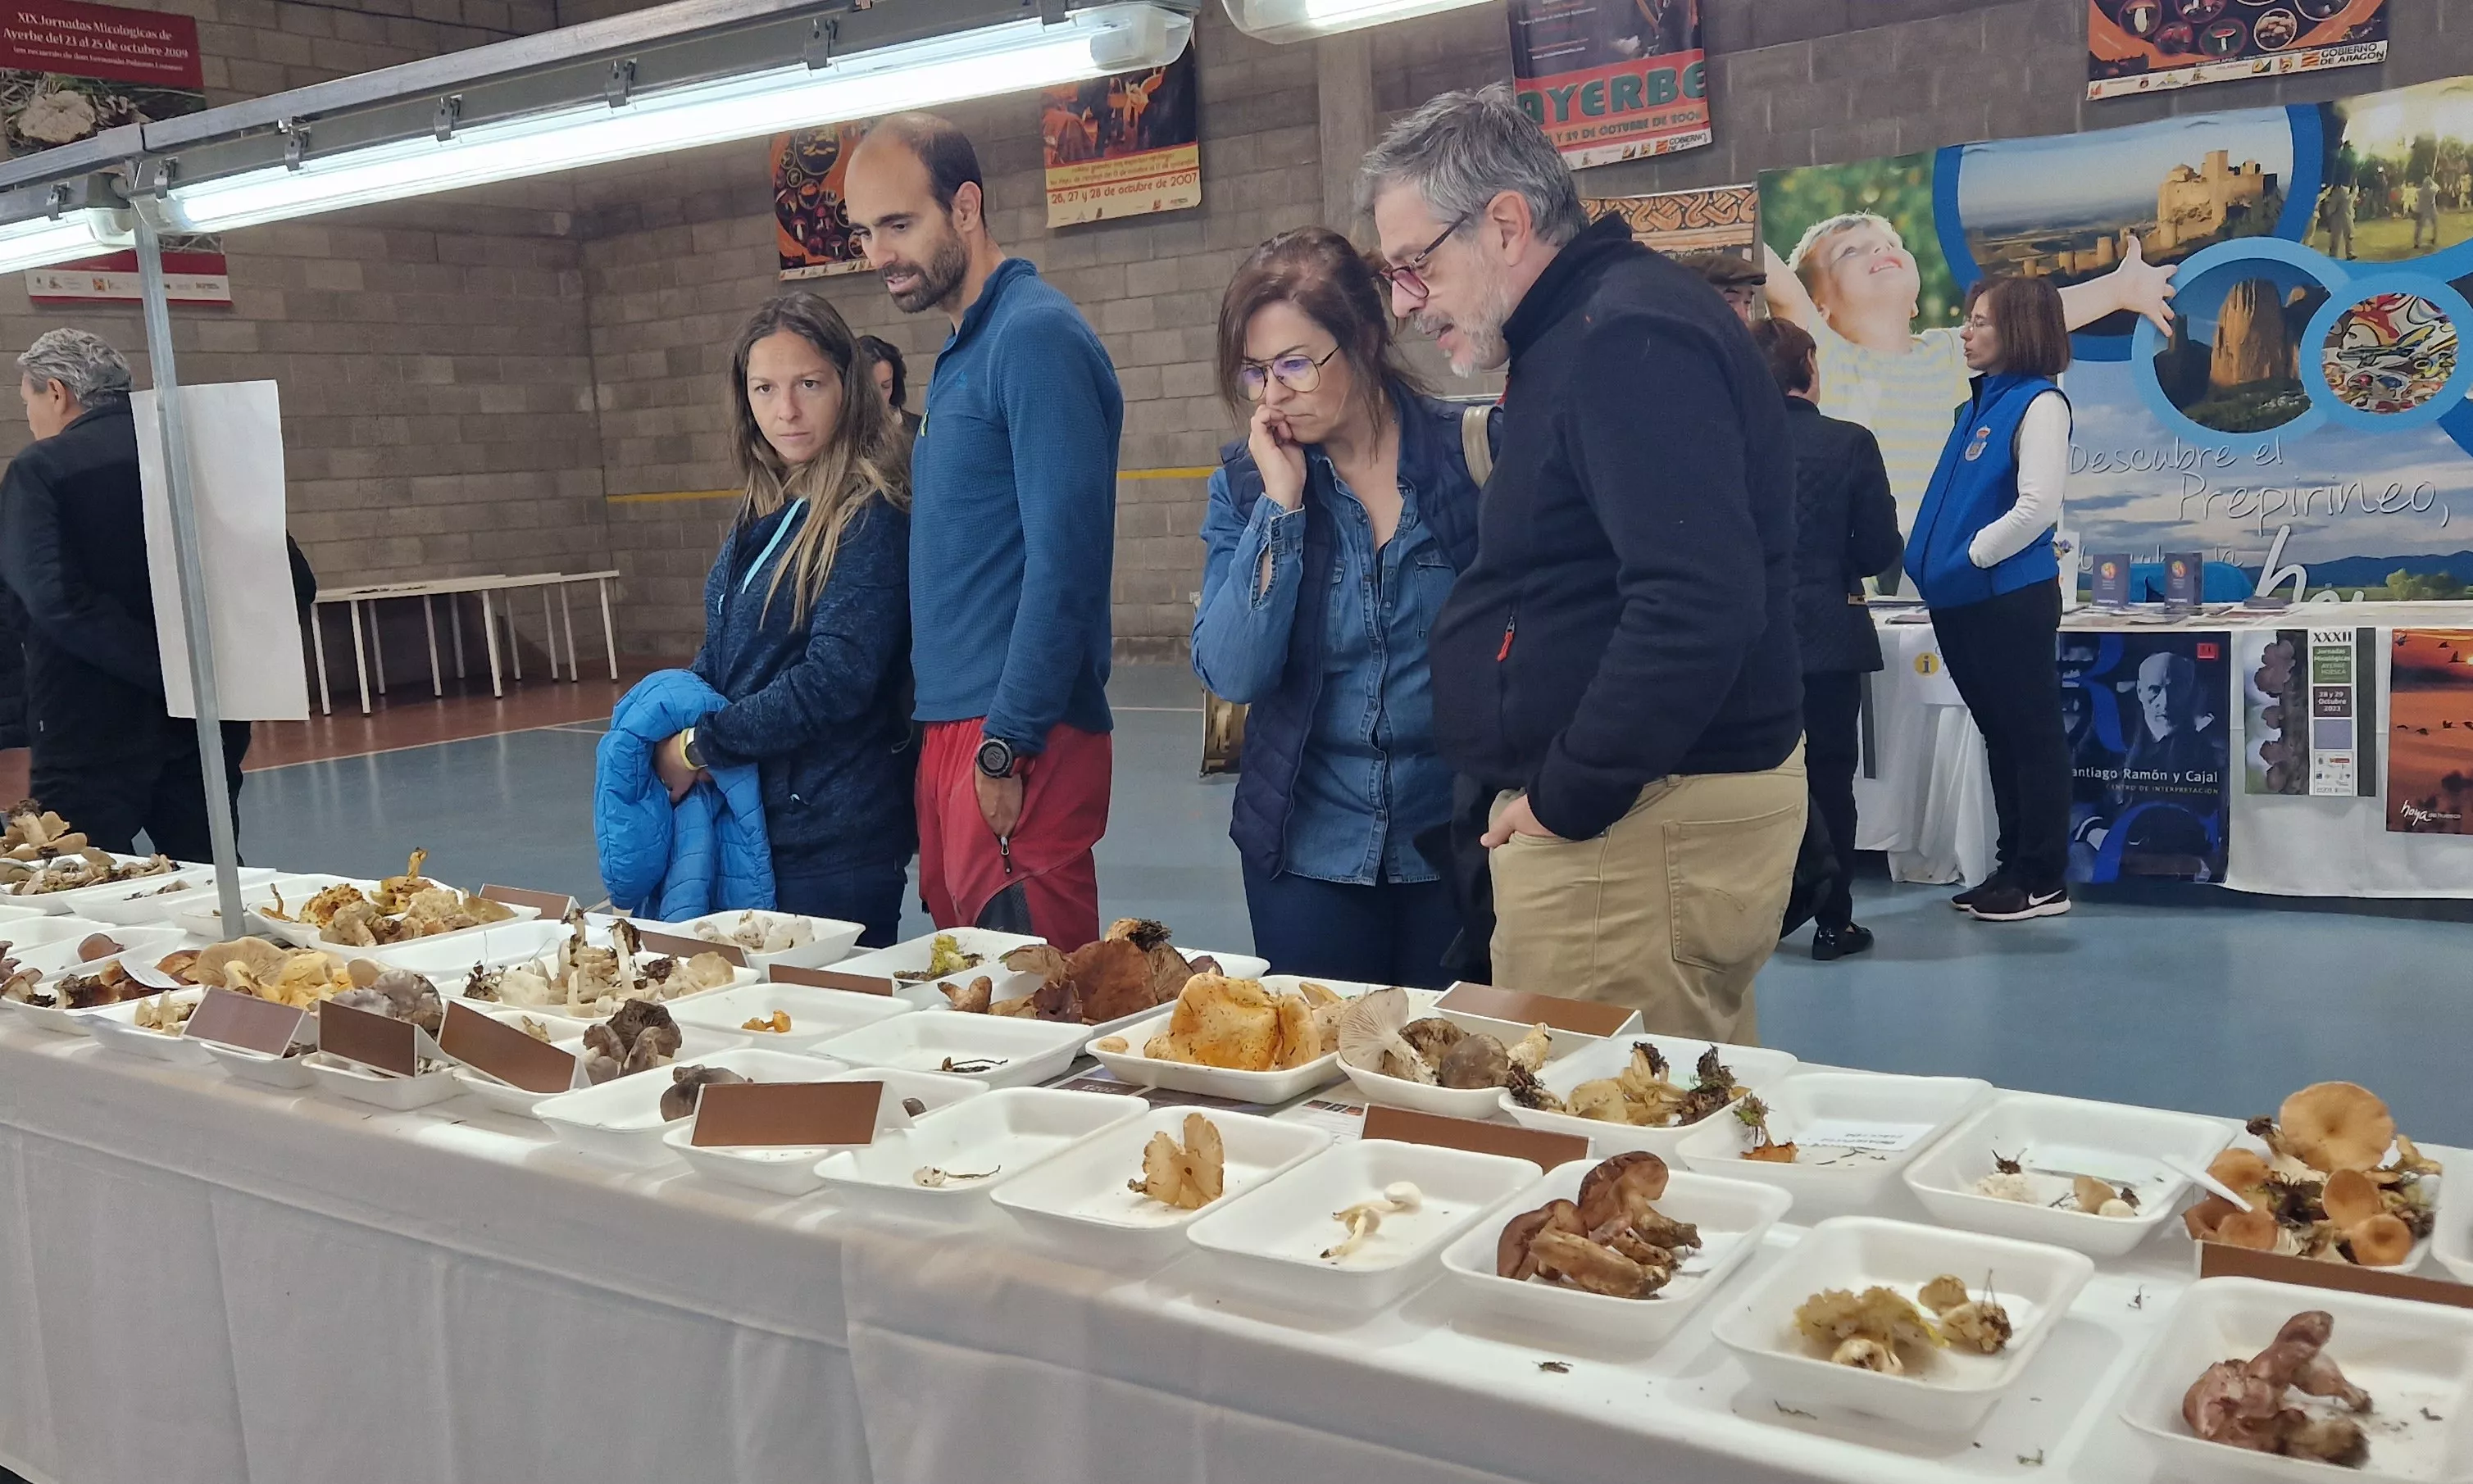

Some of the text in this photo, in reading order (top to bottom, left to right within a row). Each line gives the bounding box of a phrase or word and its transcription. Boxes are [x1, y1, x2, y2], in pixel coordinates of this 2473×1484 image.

[17, 11, 39, 24] XIX
[39, 15, 93, 31] Jornadas
[159, 29, 173, 41] de
[3, 27, 189, 59] Ayerbe del 23 al 25 de octubre 2009
[2321, 43, 2378, 58] GOBIERNO
[1517, 61, 1707, 125] AYERBE
[1068, 191, 1079, 202] 27
[1082, 192, 1088, 203] y
[1089, 188, 1102, 198] 28
[1104, 186, 1116, 197] de
[1118, 181, 1152, 194] octubre
[1156, 179, 1167, 188] de
[1171, 173, 1197, 187] 2007
[2069, 433, 2284, 474] Descubre el
[2179, 471, 2451, 538] Prepirineo,
[2313, 632, 2352, 642] XXXII
[2072, 767, 2218, 784] antiago Ramón y Cajal
[2400, 799, 2432, 827] hoya
